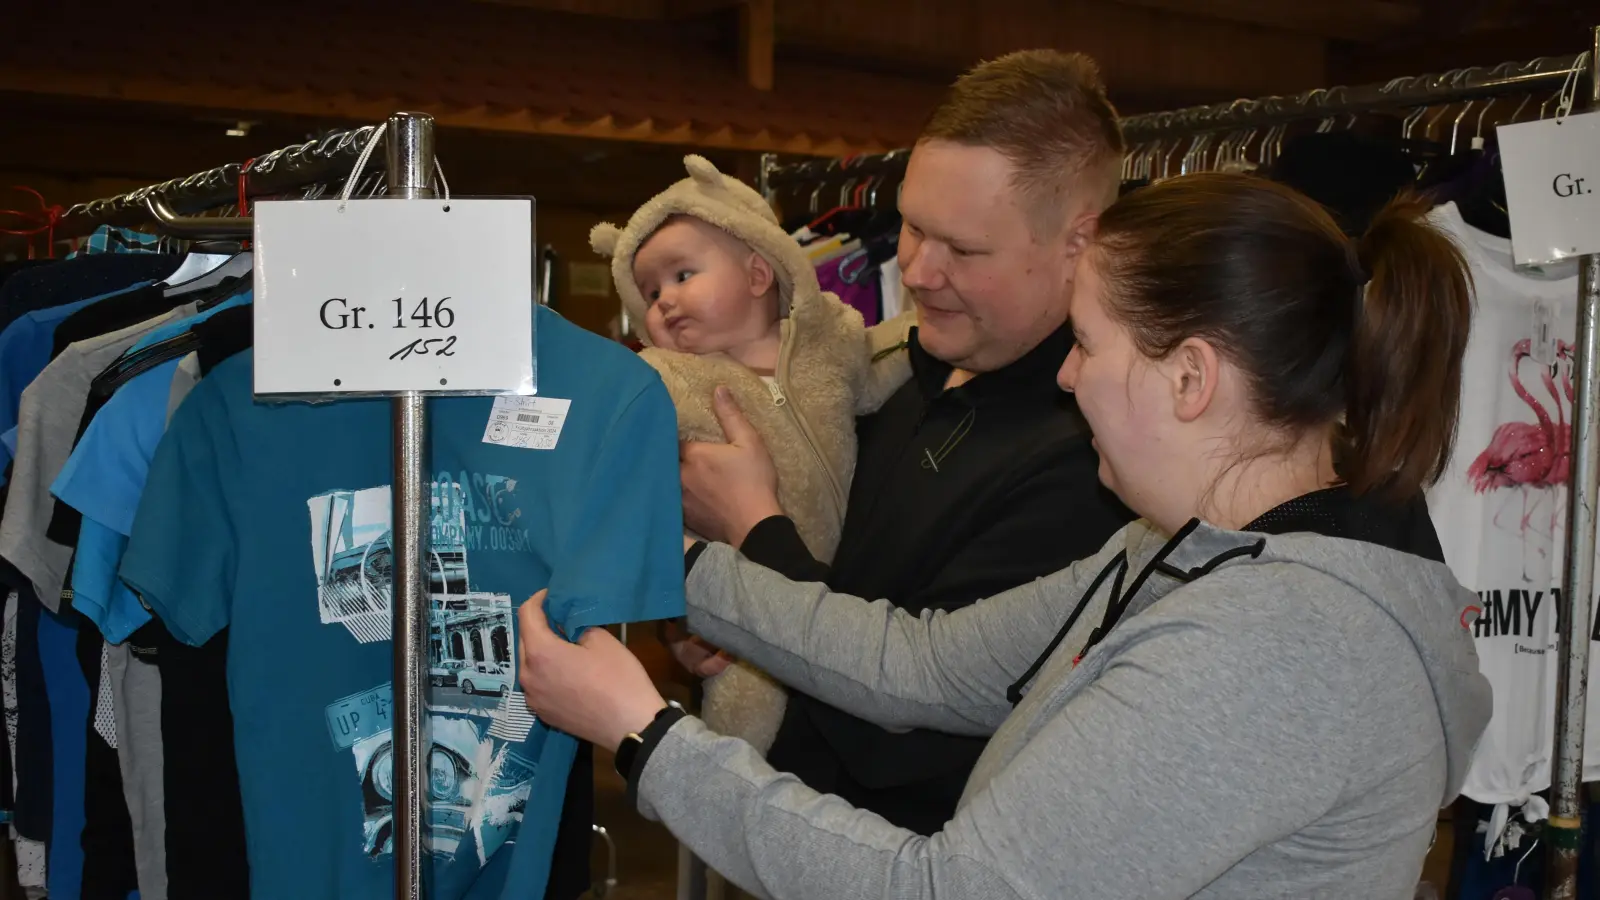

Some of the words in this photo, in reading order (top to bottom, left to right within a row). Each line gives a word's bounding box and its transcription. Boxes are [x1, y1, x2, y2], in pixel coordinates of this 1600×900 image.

[1552, 173, 1592, 198] Gr.
[319, 297, 375, 330] Gr.
[391, 296, 455, 329] 146
[389, 335, 458, 360] 152
[360, 693, 381, 706] CUBA
[336, 711, 361, 736] UP
